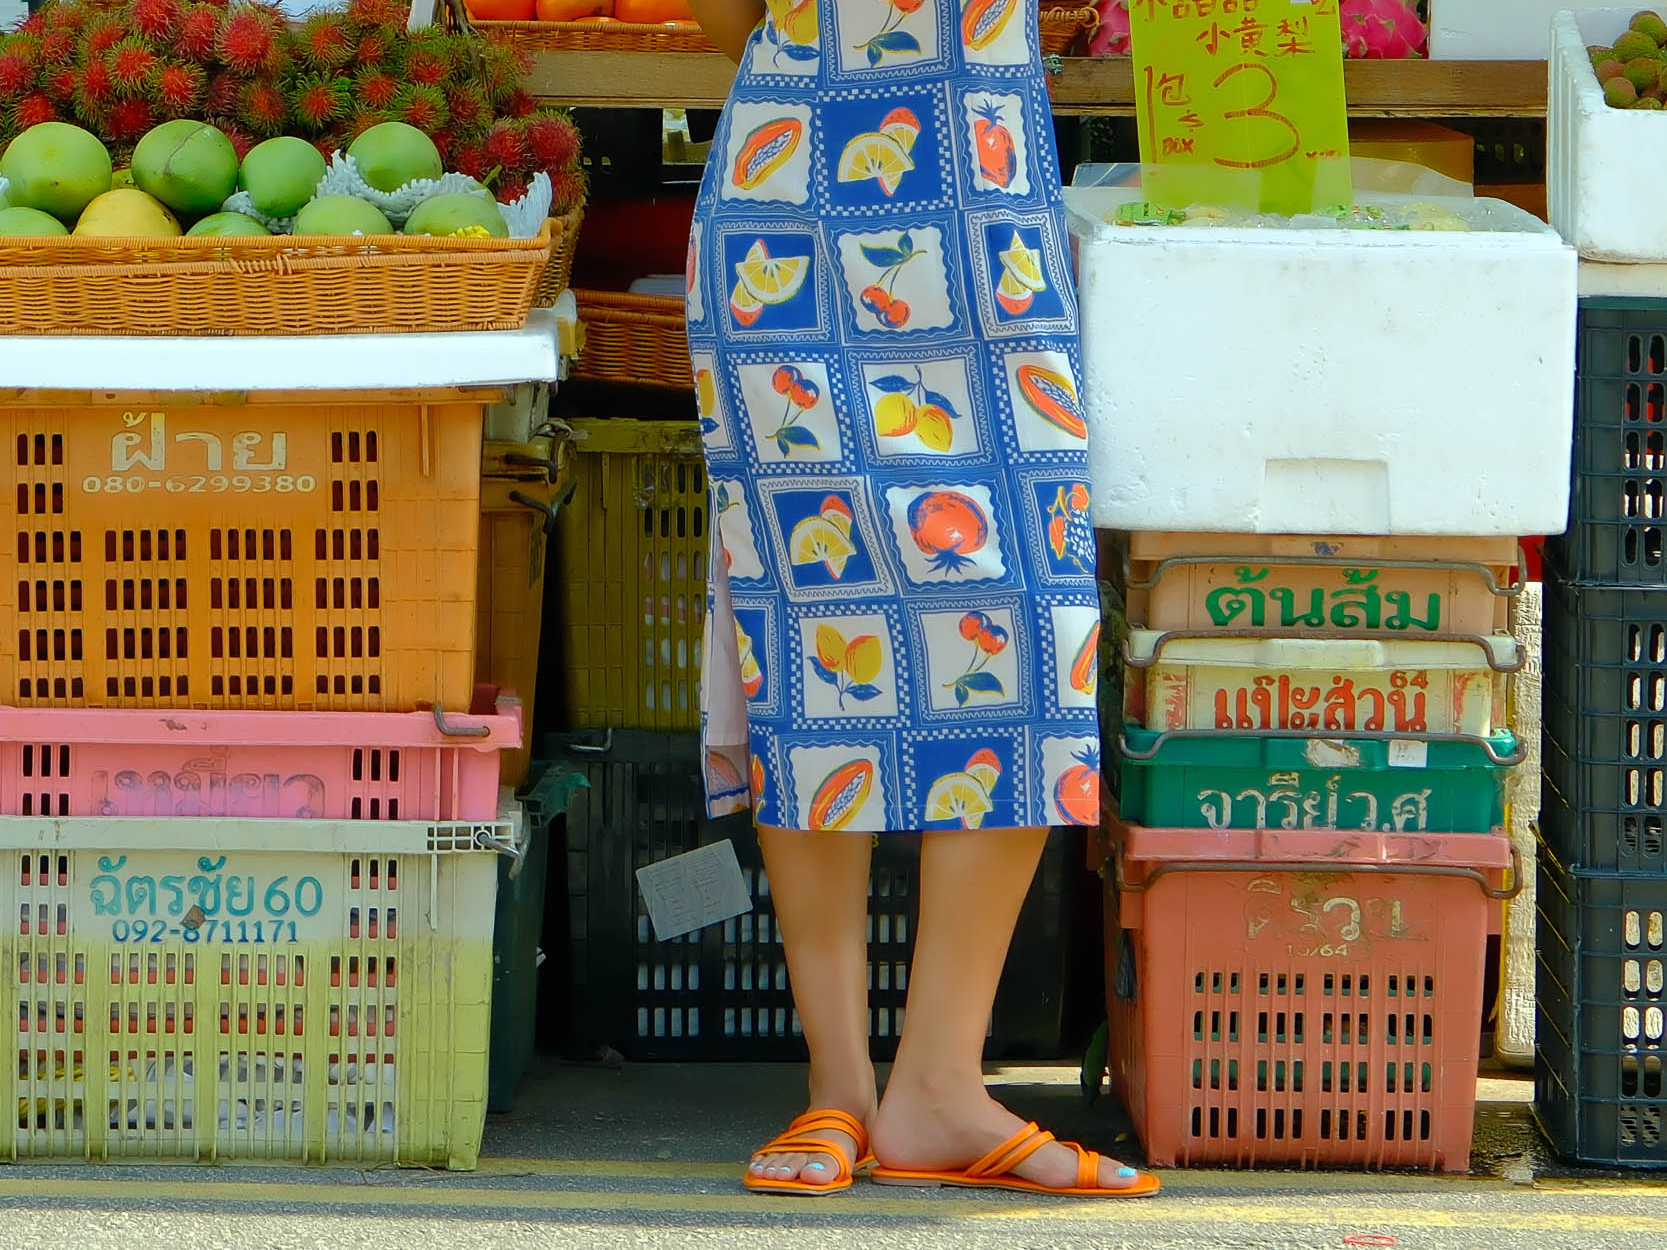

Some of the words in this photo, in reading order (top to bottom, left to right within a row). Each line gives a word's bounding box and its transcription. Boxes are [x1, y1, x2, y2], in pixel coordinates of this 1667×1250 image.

[1212, 62, 1301, 169] 3
[81, 474, 317, 494] 080-6299380
[1204, 565, 1442, 632] ต้นส้ม
[263, 875, 324, 918] 60
